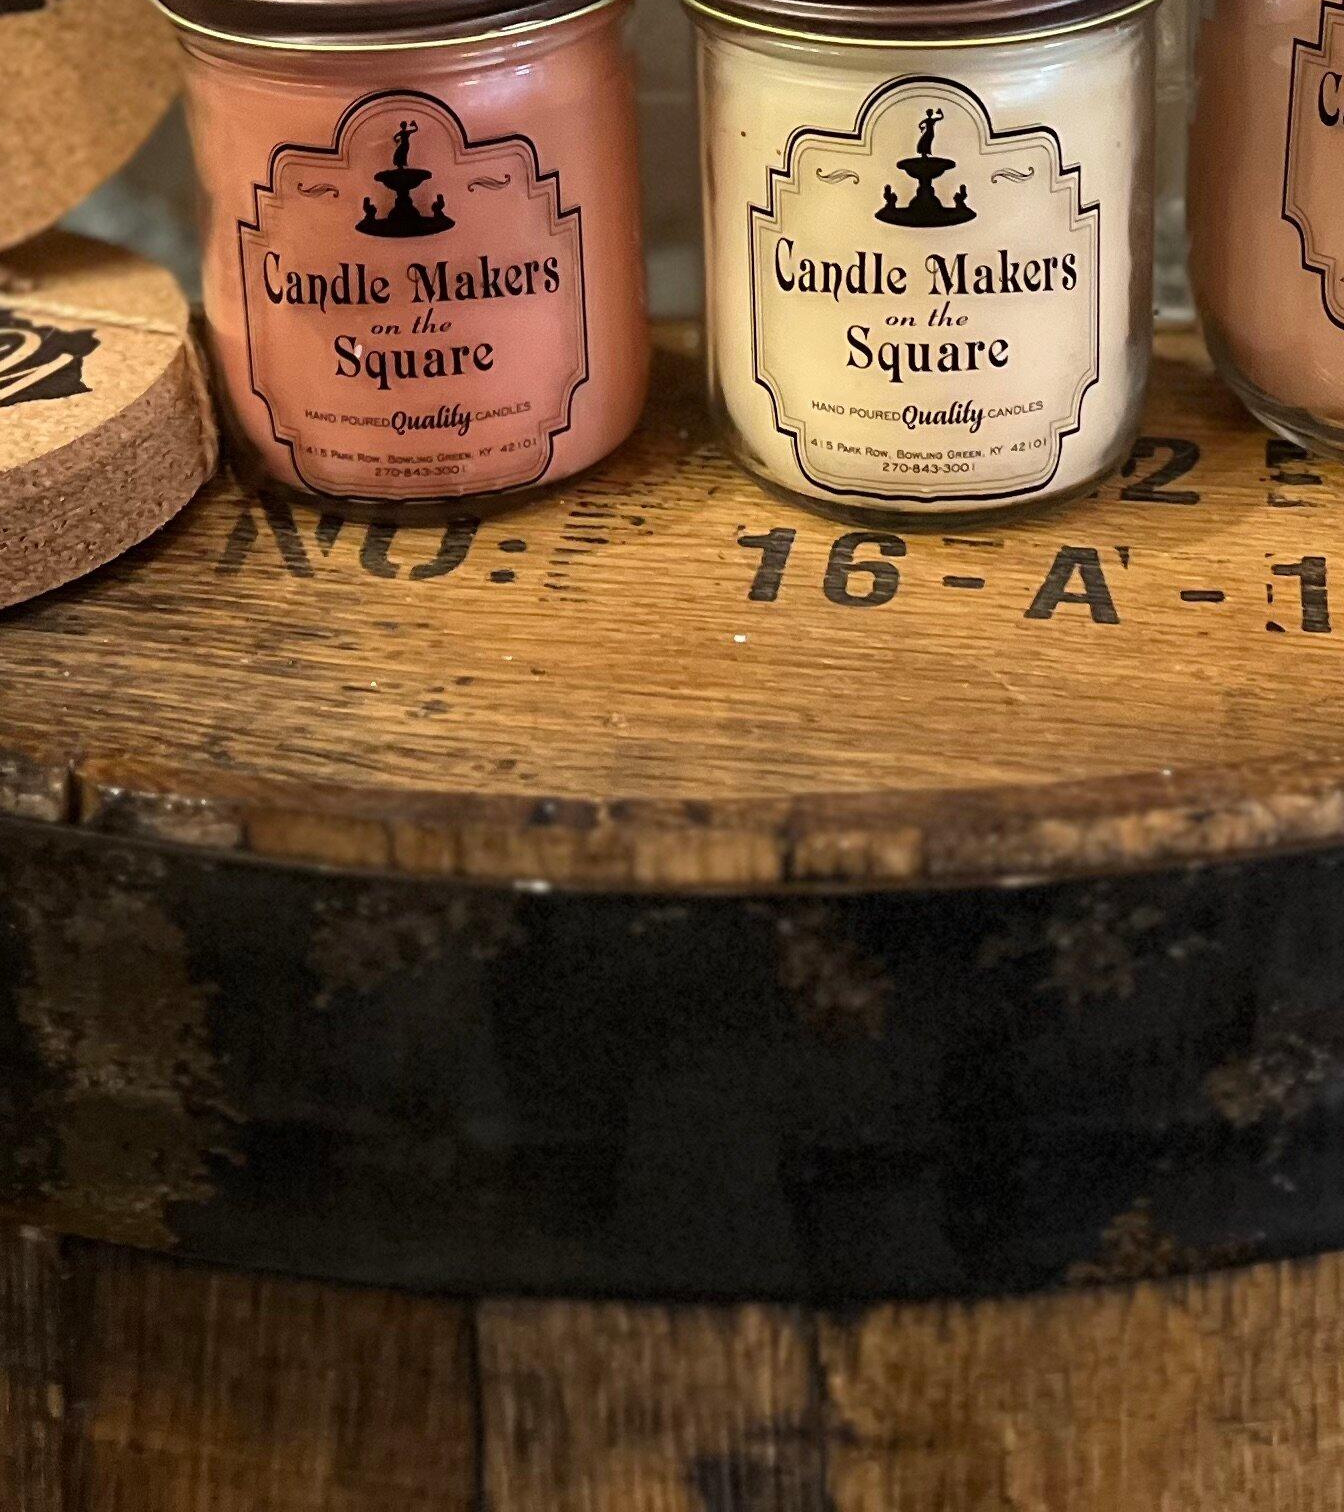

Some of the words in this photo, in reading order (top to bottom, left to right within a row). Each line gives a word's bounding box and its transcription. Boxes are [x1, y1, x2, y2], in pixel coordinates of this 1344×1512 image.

[263, 251, 391, 313] Candle
[406, 255, 561, 304] Makers
[774, 237, 908, 302] Candle
[924, 249, 1078, 296] Makers
[370, 320, 402, 336] on
[411, 308, 453, 335] the
[885, 313, 917, 327] on
[927, 301, 969, 327] the
[334, 334, 495, 390] Square
[846, 324, 1009, 383] Square
[304, 409, 337, 424] HAND
[340, 414, 391, 428] POURED
[391, 403, 473, 436] Quality
[474, 401, 532, 421] CANDLES
[811, 400, 845, 415] HAND
[849, 407, 901, 422] POURED
[902, 399, 984, 433] Quality
[987, 400, 1044, 419] CANDLES
[811, 438, 834, 450] 415
[990, 444, 1004, 456] KY
[1010, 437, 1048, 453] 42101
[882, 462, 976, 474] 270-843-3001
